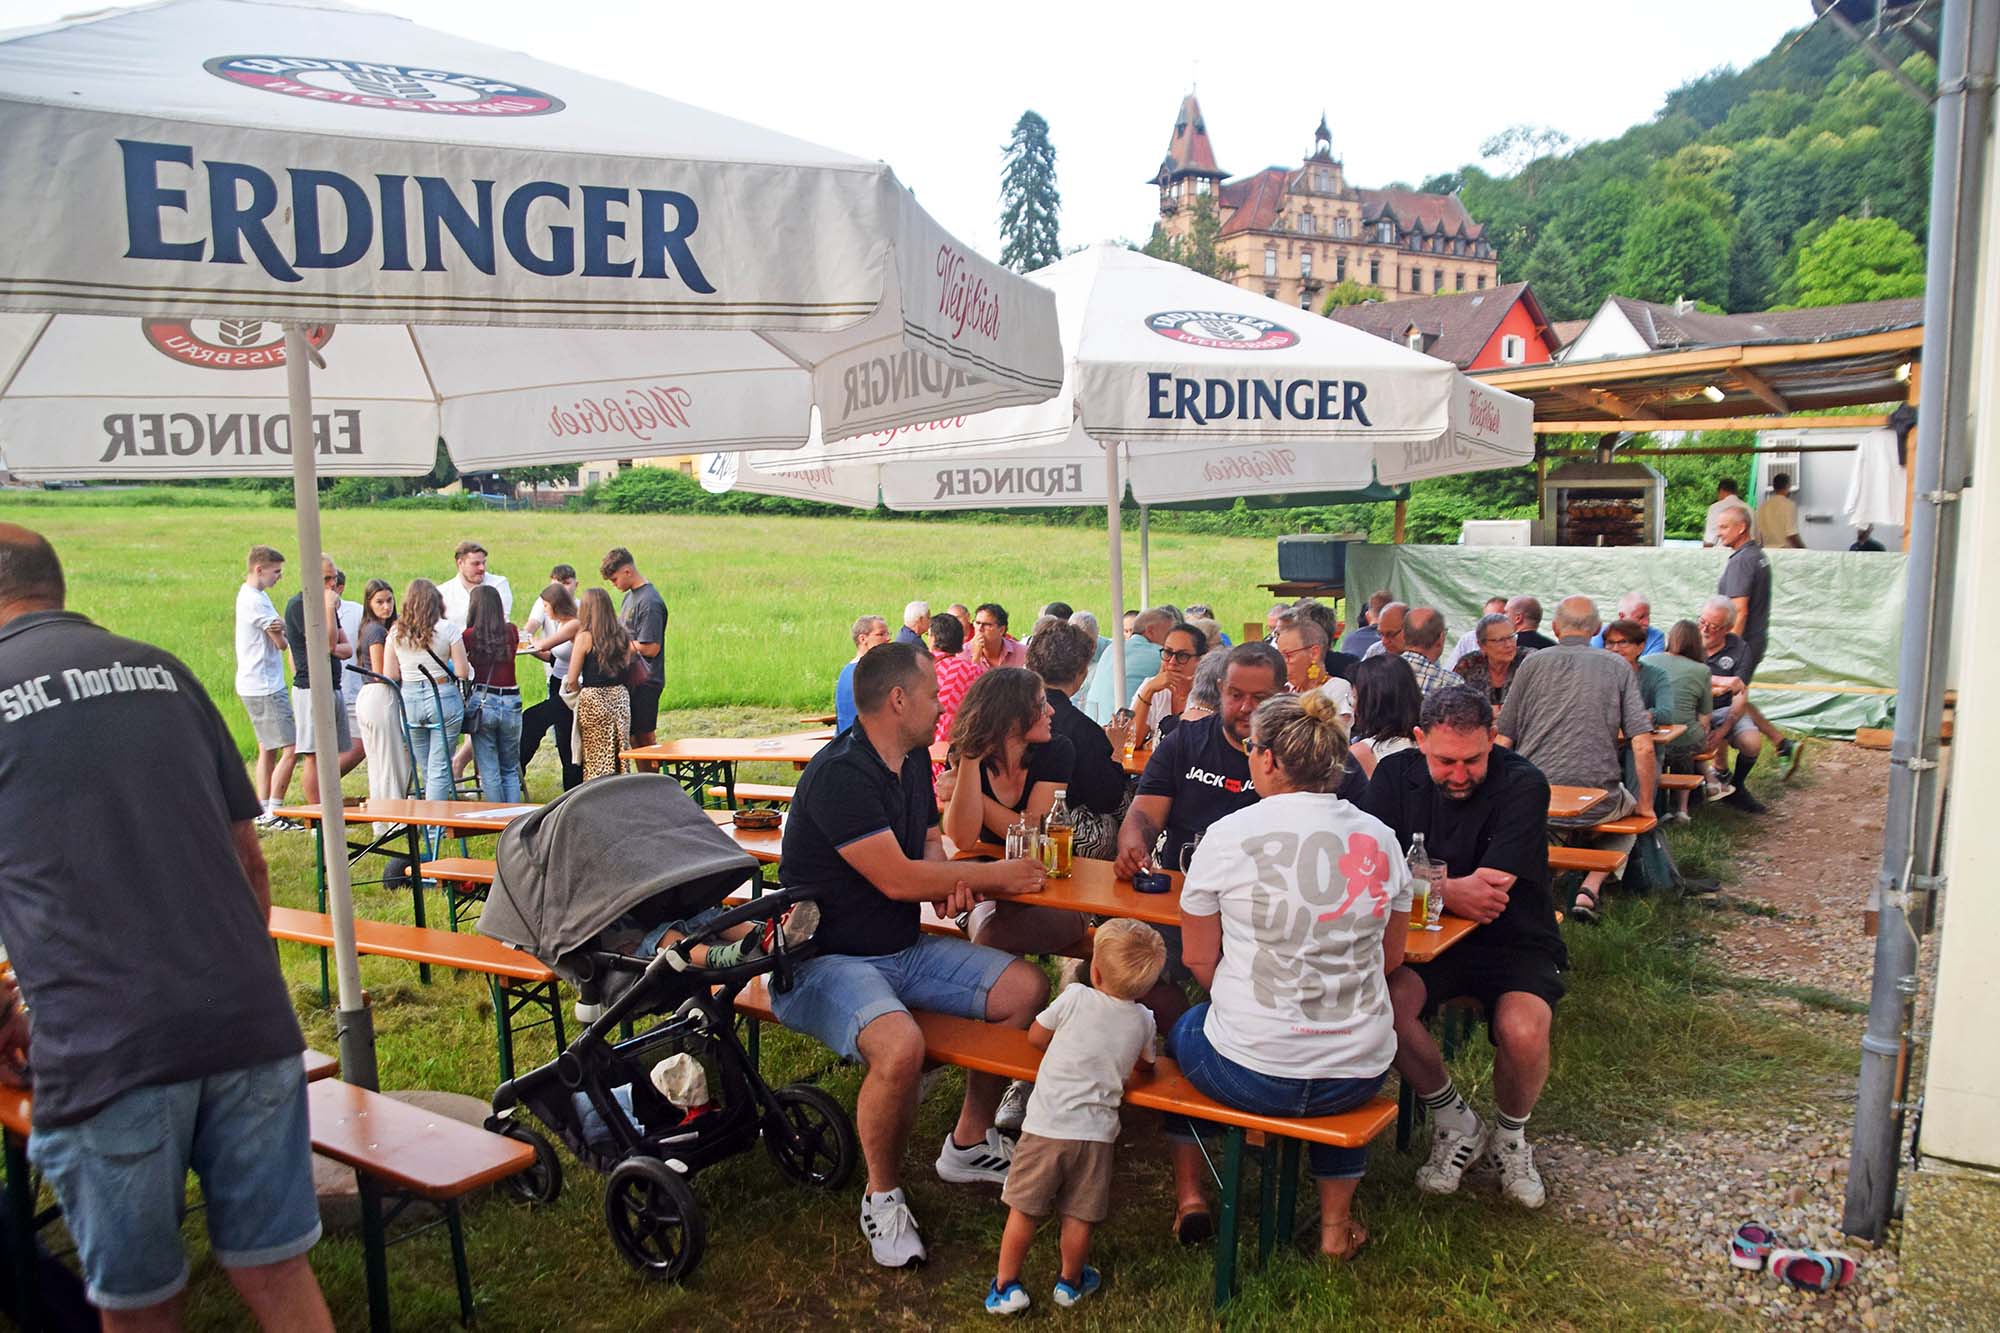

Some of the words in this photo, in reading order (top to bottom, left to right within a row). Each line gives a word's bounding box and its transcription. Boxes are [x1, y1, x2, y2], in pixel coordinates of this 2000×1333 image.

[116, 138, 717, 294] ERDINGER
[936, 244, 1000, 341] Weißbier
[1146, 371, 1374, 427] ERDINGER
[0, 674, 61, 722] SKC
[1185, 766, 1225, 788] JACK
